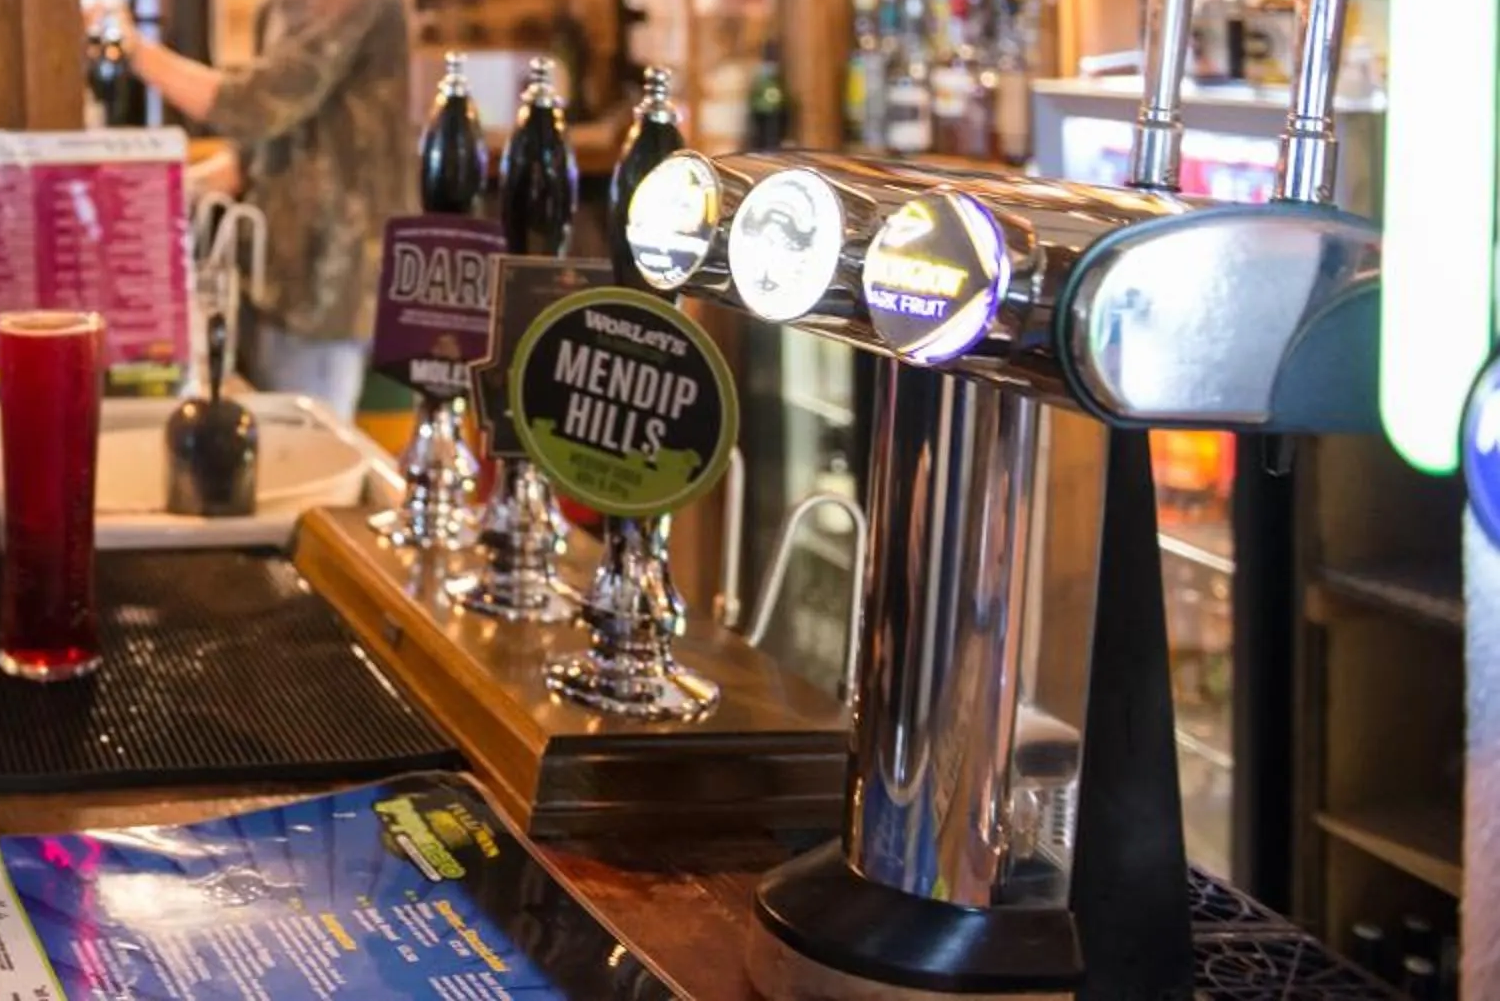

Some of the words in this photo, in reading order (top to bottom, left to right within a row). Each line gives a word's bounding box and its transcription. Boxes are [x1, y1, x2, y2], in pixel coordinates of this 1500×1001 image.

[389, 242, 490, 311] DAR
[554, 339, 699, 420] MENDIP
[564, 393, 667, 463] HILLS
